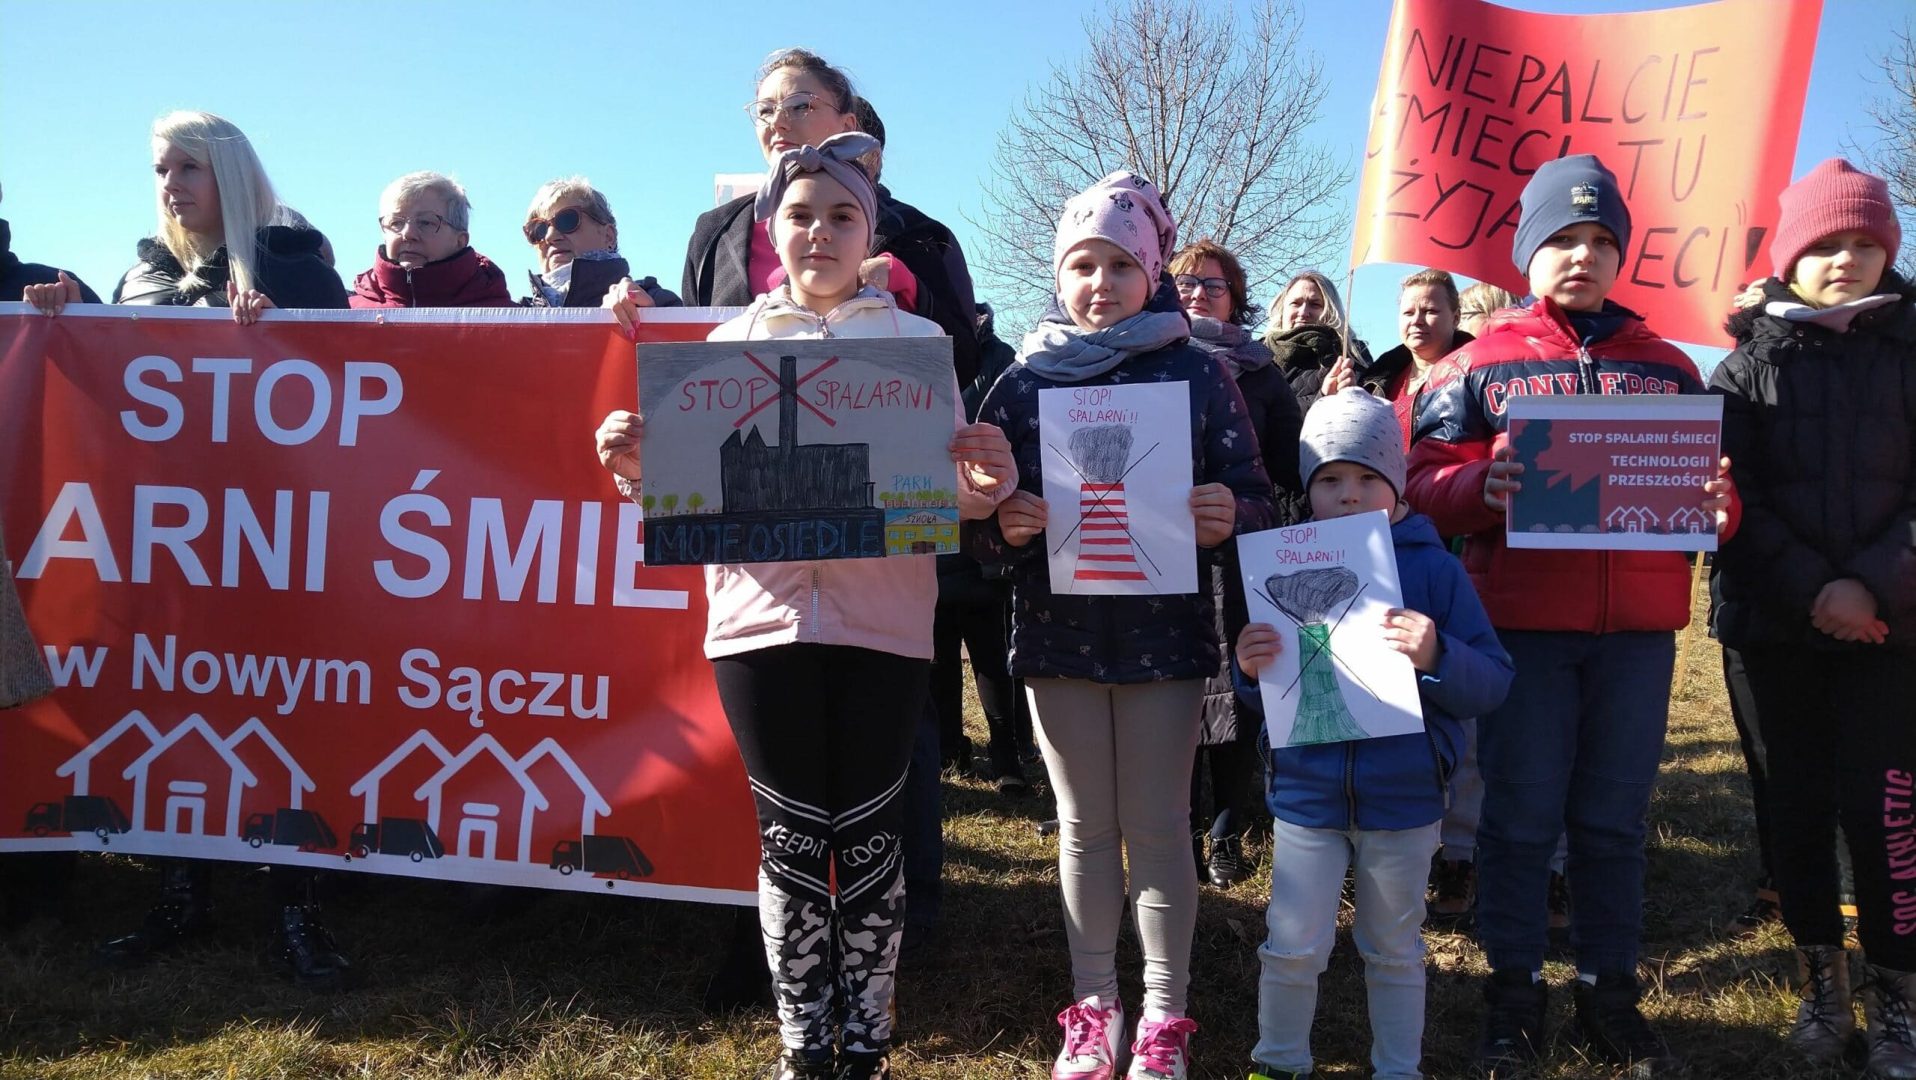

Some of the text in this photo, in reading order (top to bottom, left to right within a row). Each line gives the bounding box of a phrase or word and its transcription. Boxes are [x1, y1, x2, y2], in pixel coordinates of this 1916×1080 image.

[1618, 134, 1707, 202] TU
[119, 355, 404, 447] STOP
[679, 376, 933, 411] STOP SPALARNI
[1073, 387, 1112, 407] STOP!
[1568, 430, 1717, 445] STOP SPALARNI ŚMIECI
[1610, 454, 1710, 468] TECHNOLOGII
[890, 474, 933, 492] PARK
[6, 469, 690, 610] ARNI ŚMIE
[1280, 526, 1317, 544] STOP!
[44, 633, 611, 728] w Nowym Sączu
